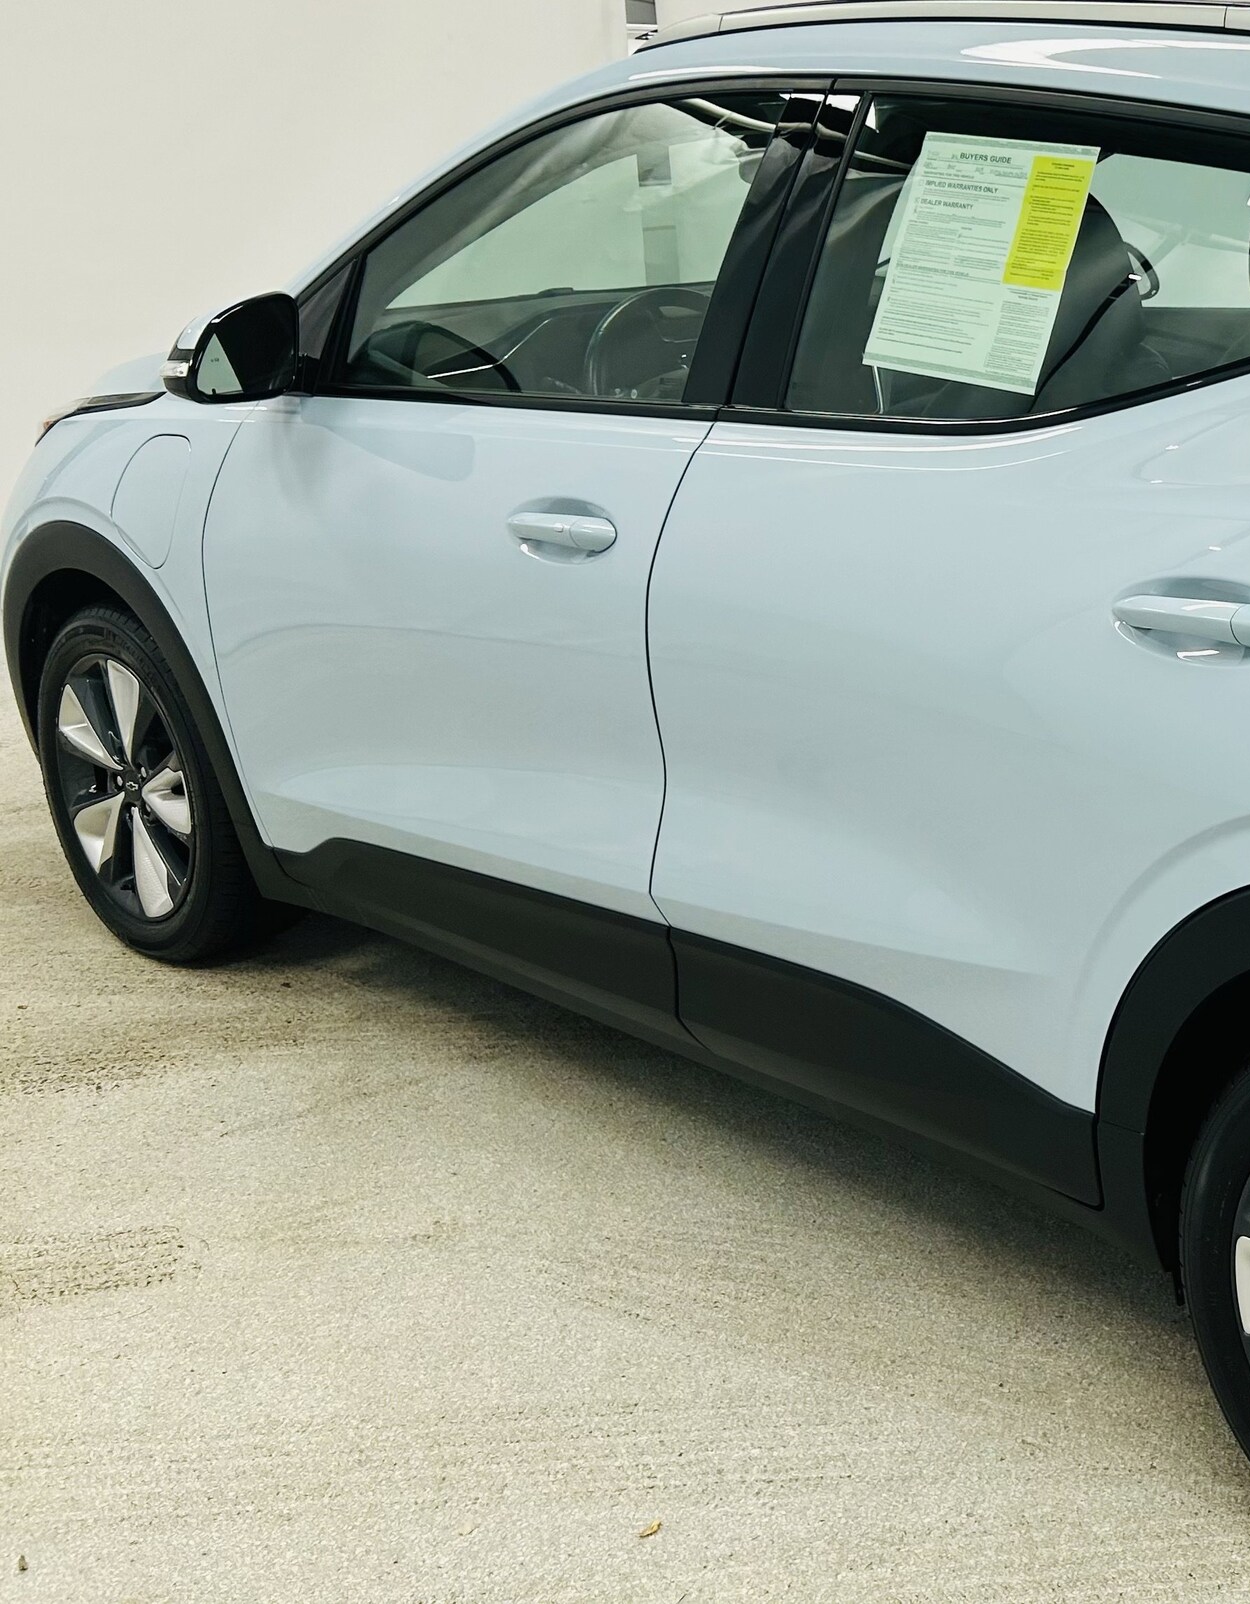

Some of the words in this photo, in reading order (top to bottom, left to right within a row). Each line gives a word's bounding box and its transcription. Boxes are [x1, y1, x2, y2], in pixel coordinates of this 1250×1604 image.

[960, 153, 988, 162] BUYERS
[990, 155, 1012, 164] GUIDE
[925, 180, 946, 188] IMPLIED
[947, 182, 983, 192] WARRANTIES
[983, 186, 999, 194] ONLY
[943, 201, 973, 209] WARRANTY
